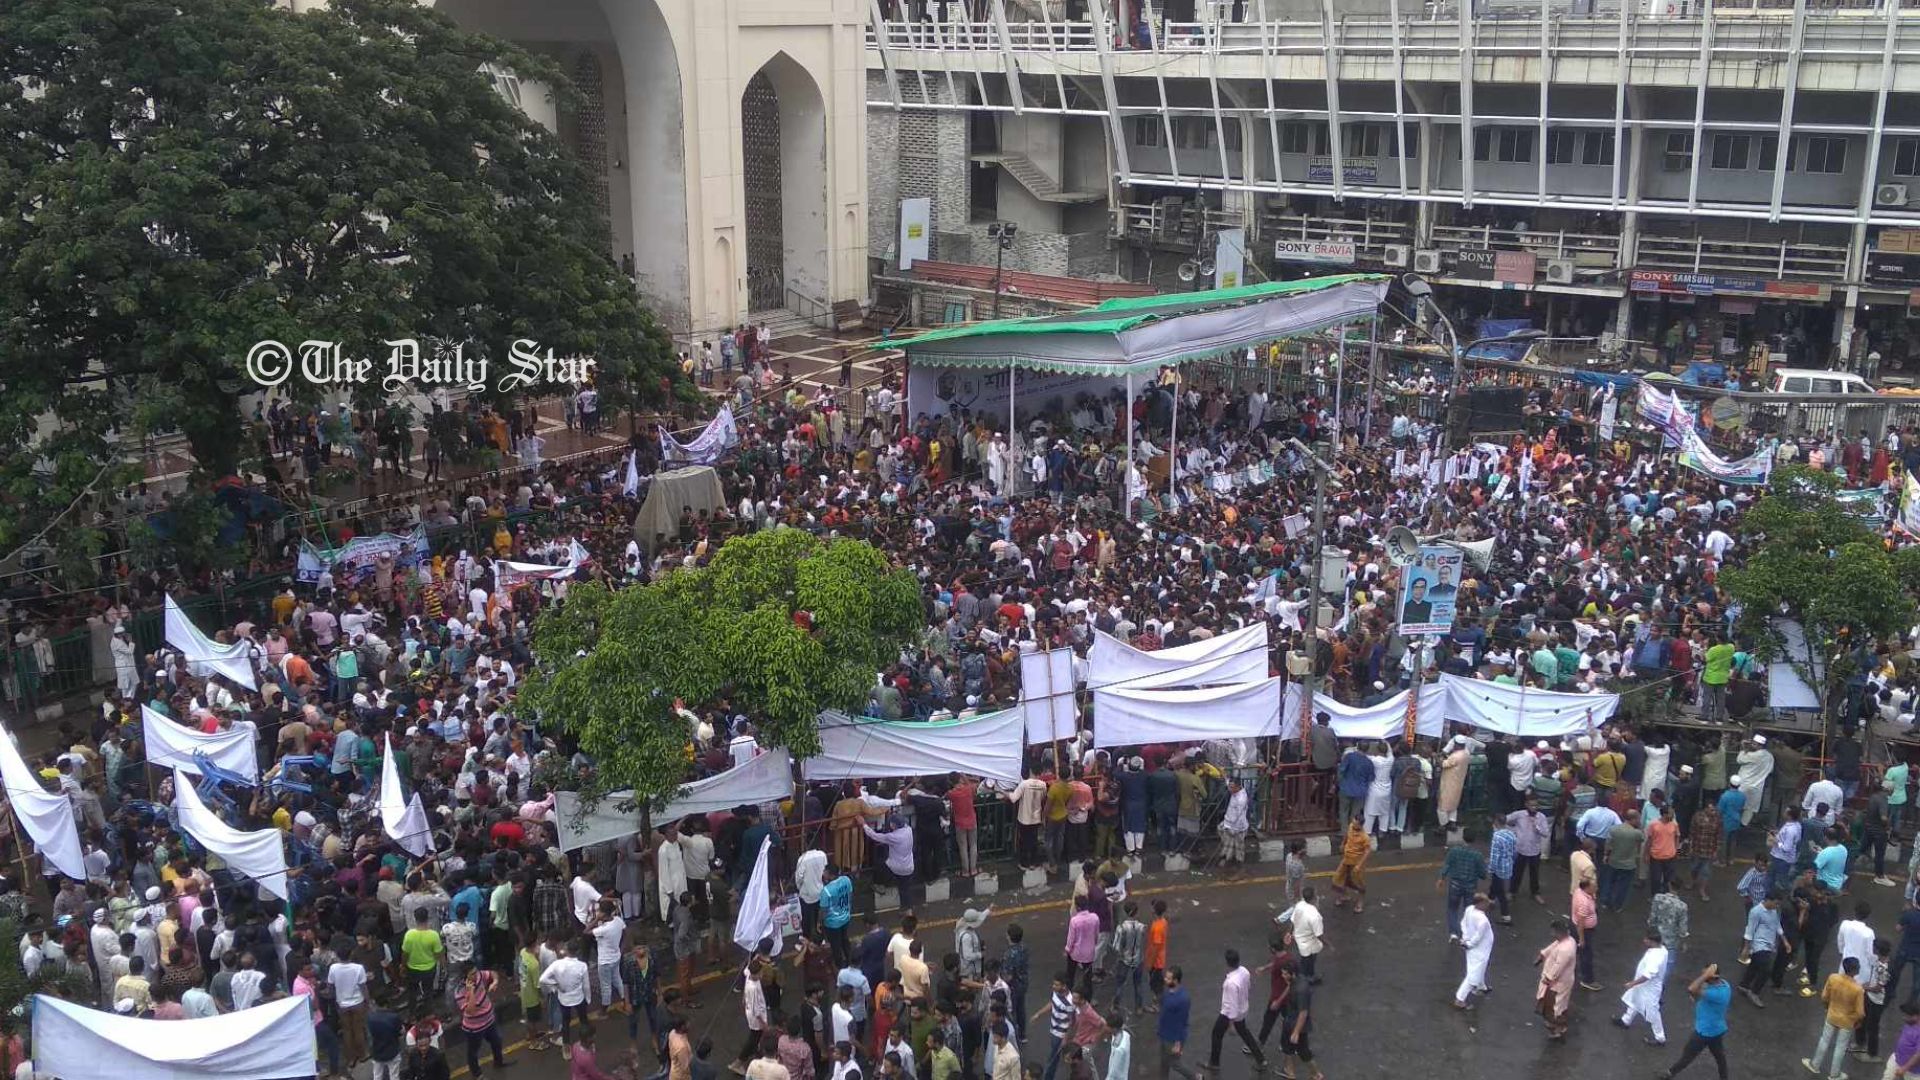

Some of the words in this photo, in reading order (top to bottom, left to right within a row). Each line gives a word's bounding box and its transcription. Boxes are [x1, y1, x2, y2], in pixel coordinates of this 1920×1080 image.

[1278, 242, 1311, 253] SONY
[1314, 244, 1353, 256] BRAVIA
[1460, 251, 1494, 263] SONY
[1632, 271, 1672, 281] SONY
[1672, 274, 1715, 284] SAMSUNG
